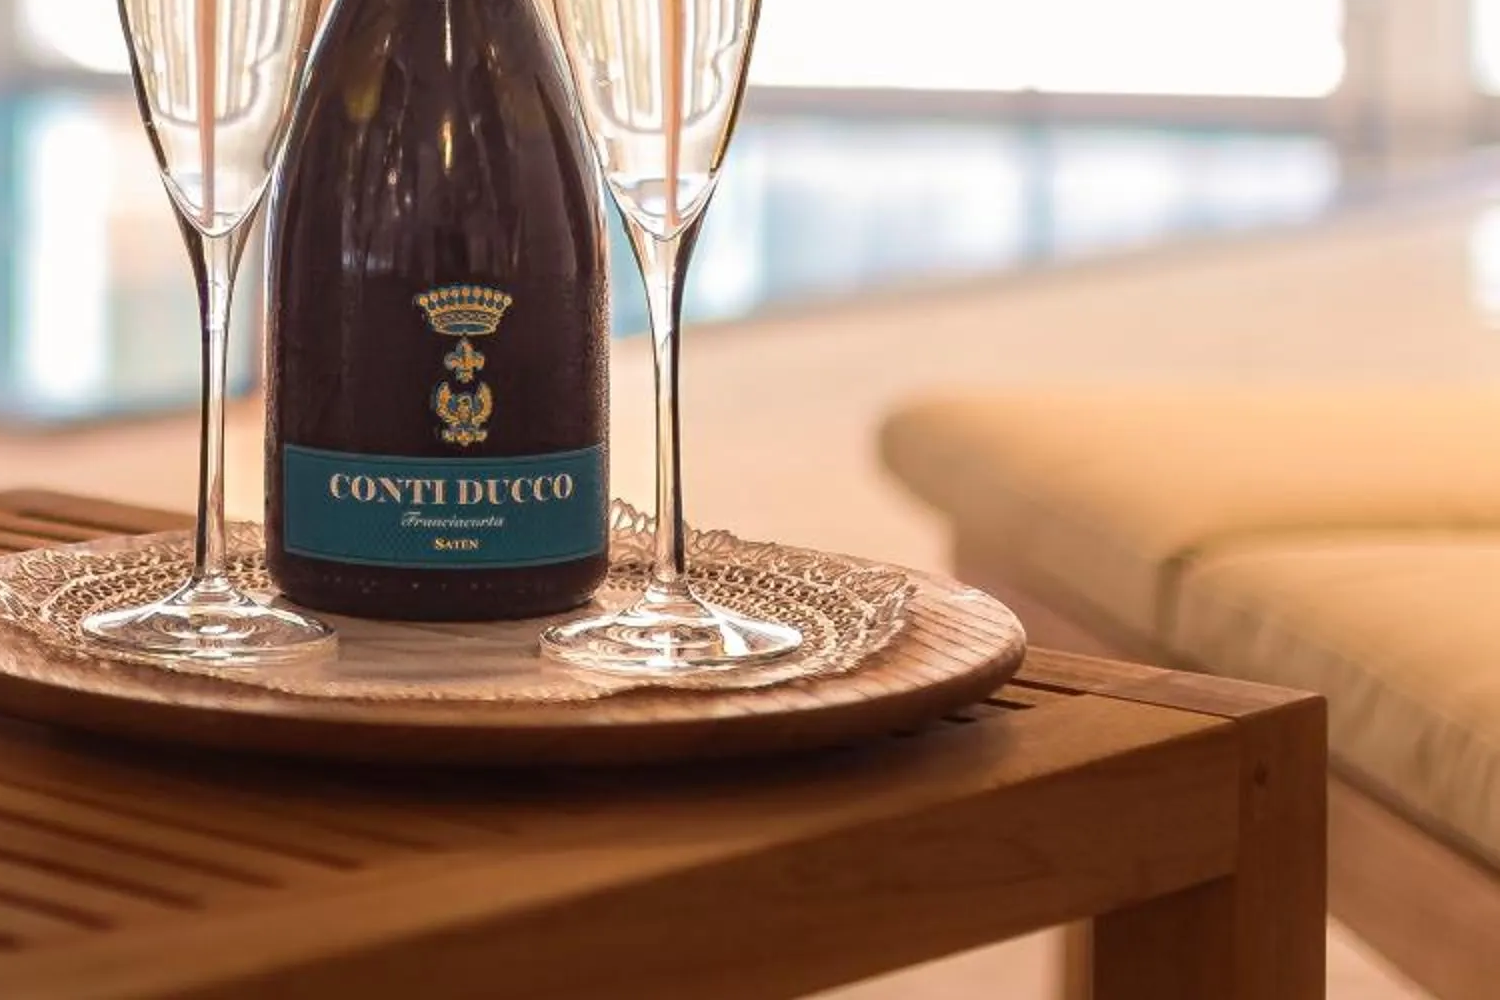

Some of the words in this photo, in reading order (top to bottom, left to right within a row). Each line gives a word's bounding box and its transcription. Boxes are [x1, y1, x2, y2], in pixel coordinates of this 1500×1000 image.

[329, 473, 447, 505] CONTI
[457, 473, 573, 505] DUCCO
[401, 511, 504, 528] Franciacorta
